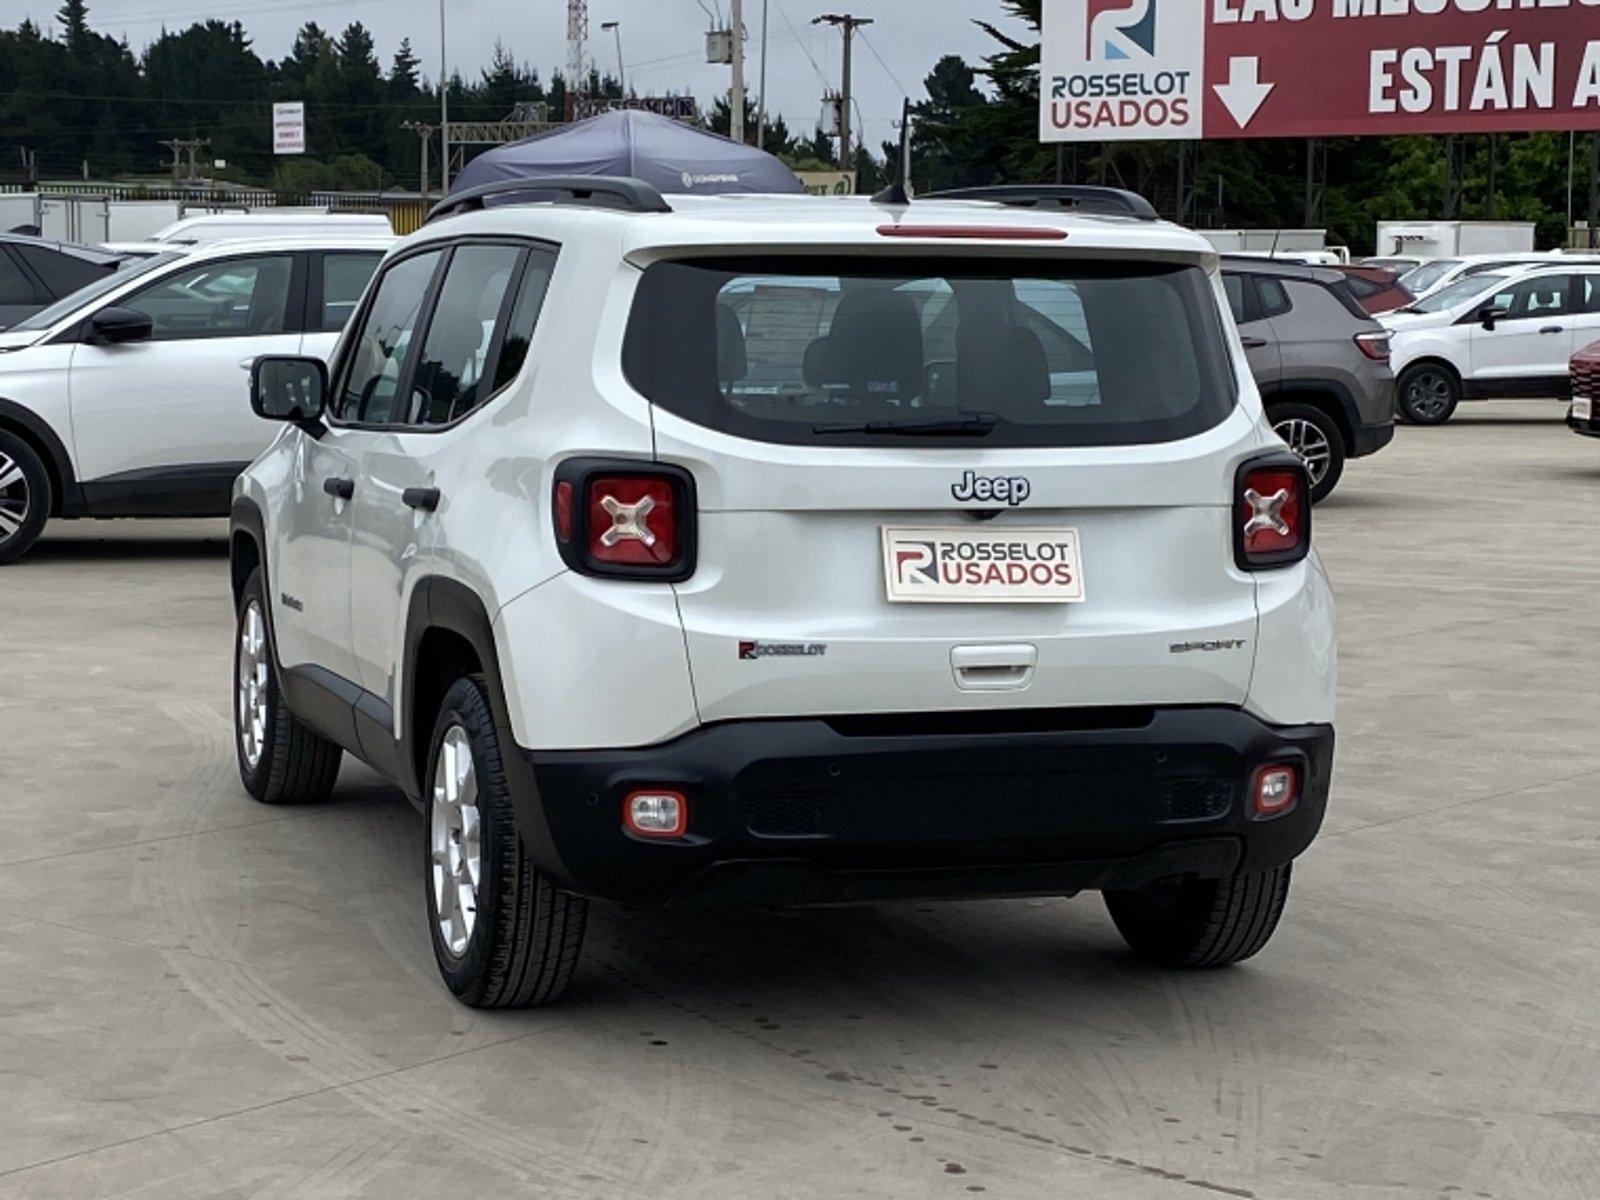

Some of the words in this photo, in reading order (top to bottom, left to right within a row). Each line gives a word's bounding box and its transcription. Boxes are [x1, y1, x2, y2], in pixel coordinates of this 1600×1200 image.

[1052, 71, 1190, 99] ROSSELOT
[1368, 29, 1555, 113] ESTÁN
[1052, 98, 1190, 129] USADOS
[951, 470, 1030, 506] Jeep
[940, 542, 1069, 562] ROSSELOT
[942, 562, 1073, 586] USADOS
[1169, 638, 1247, 654] SPORT
